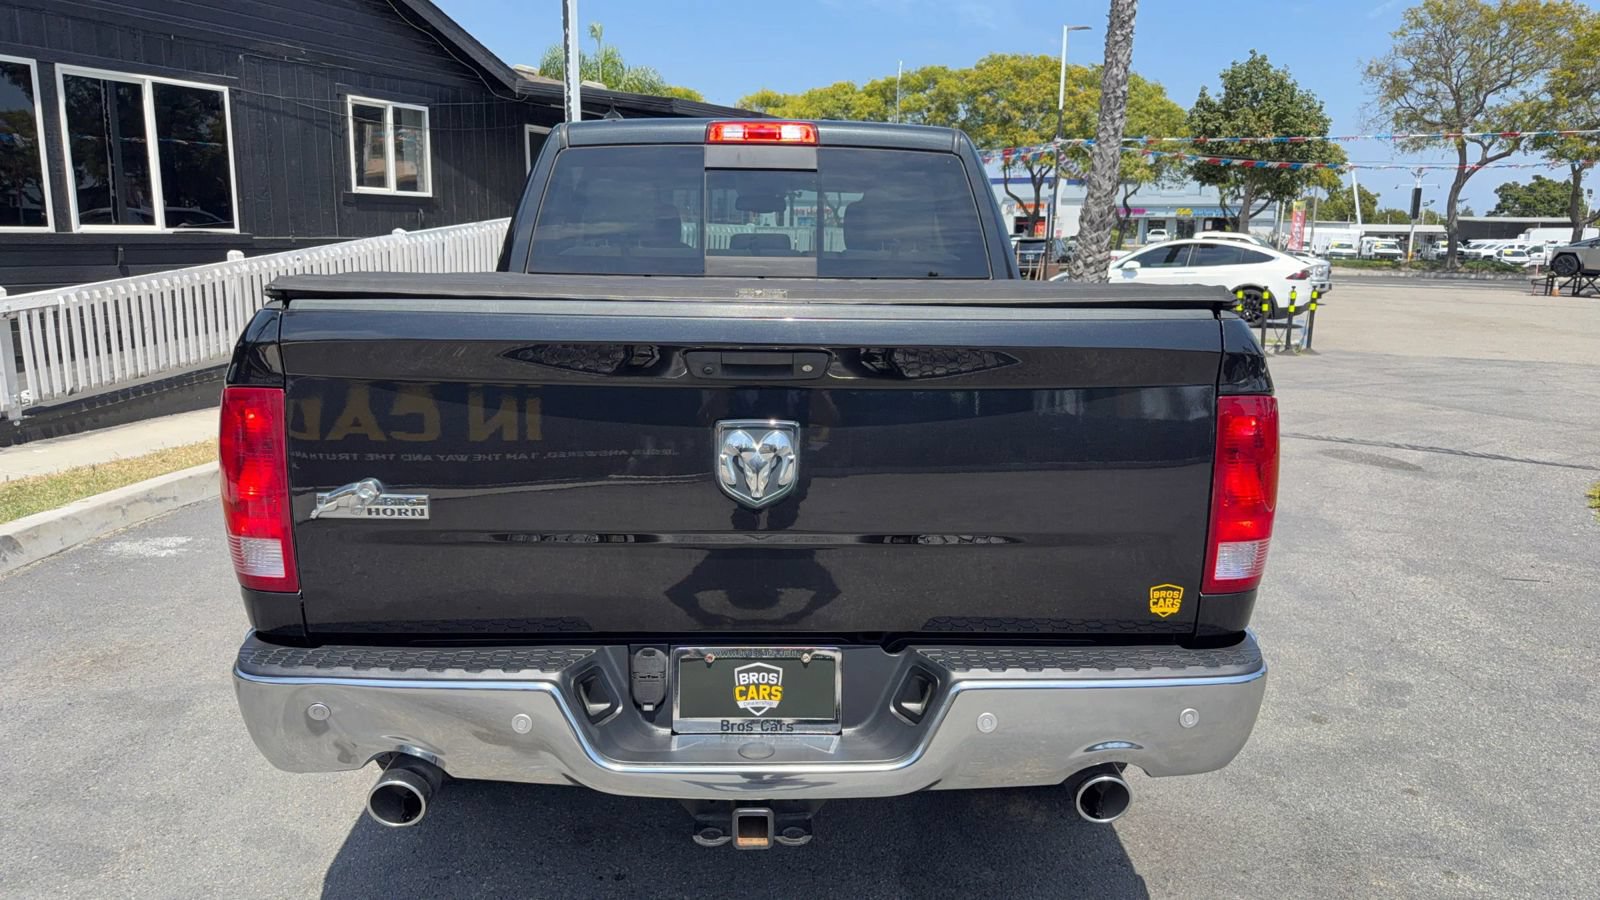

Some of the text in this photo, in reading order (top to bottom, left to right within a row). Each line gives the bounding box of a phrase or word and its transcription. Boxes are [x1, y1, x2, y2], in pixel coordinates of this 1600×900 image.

[367, 508, 425, 517] HORN
[1153, 590, 1180, 599] BROS
[1150, 598, 1181, 608] CARS
[739, 672, 778, 686] BROS
[734, 686, 783, 701] CARS
[720, 719, 794, 732] Bros Cars
